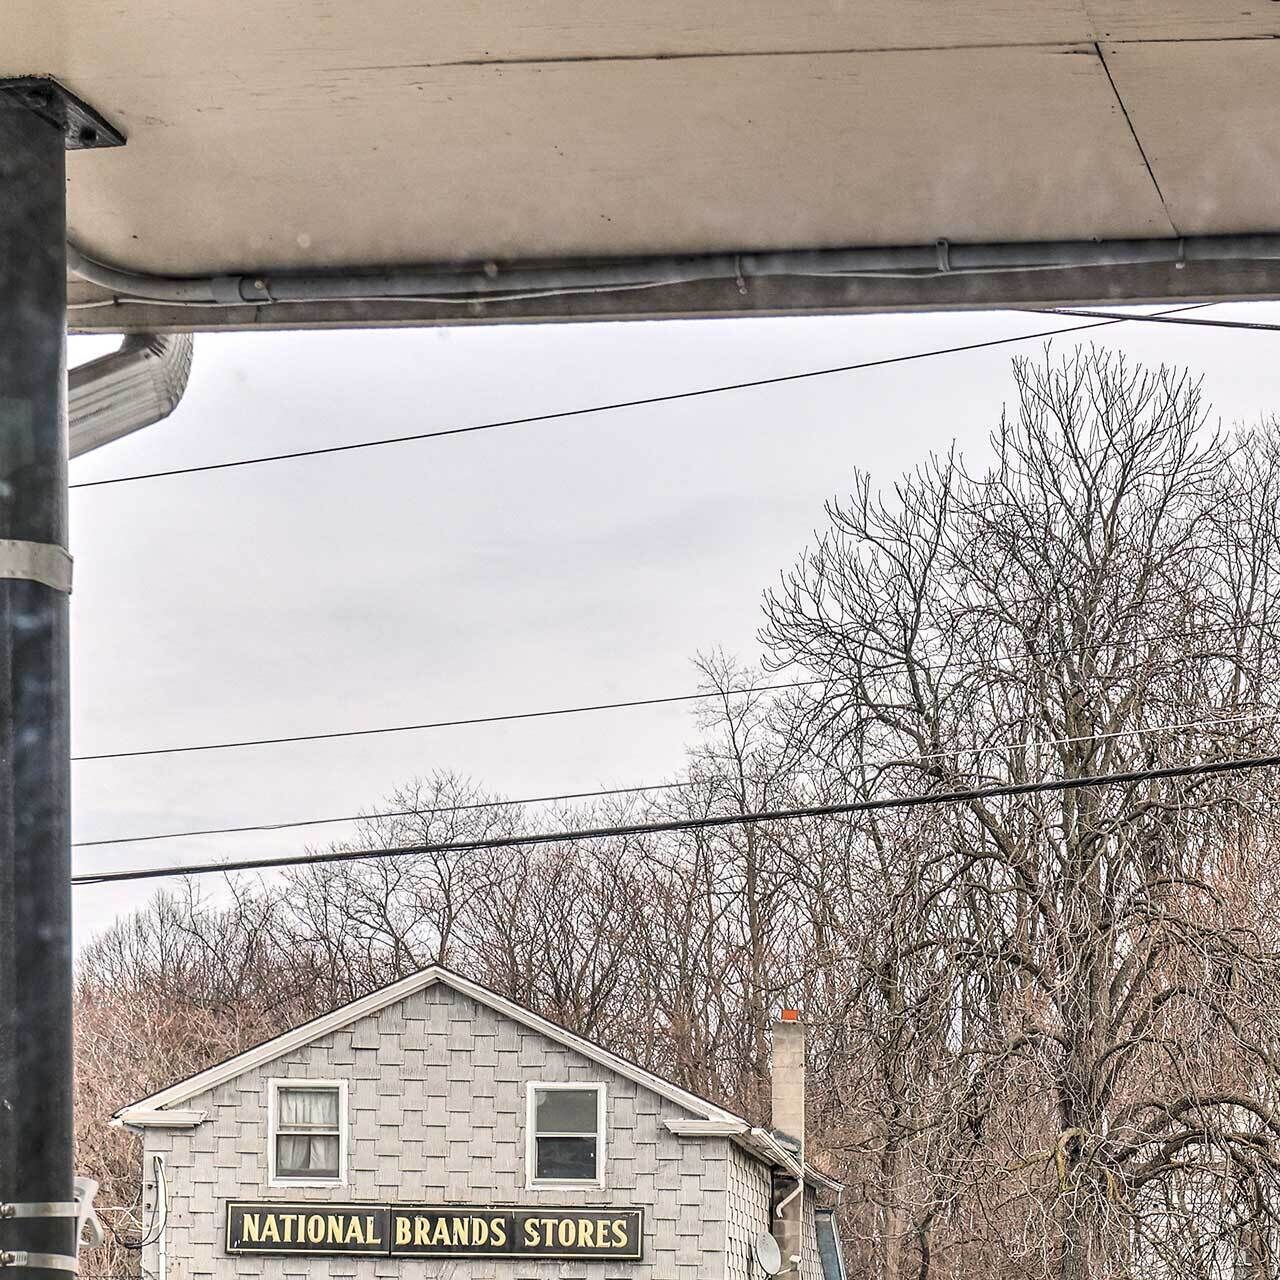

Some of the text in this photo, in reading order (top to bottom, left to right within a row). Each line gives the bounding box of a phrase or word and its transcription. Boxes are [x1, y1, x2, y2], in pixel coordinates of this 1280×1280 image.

[241, 1212, 629, 1250] NATIONAL BRANDS STORES
